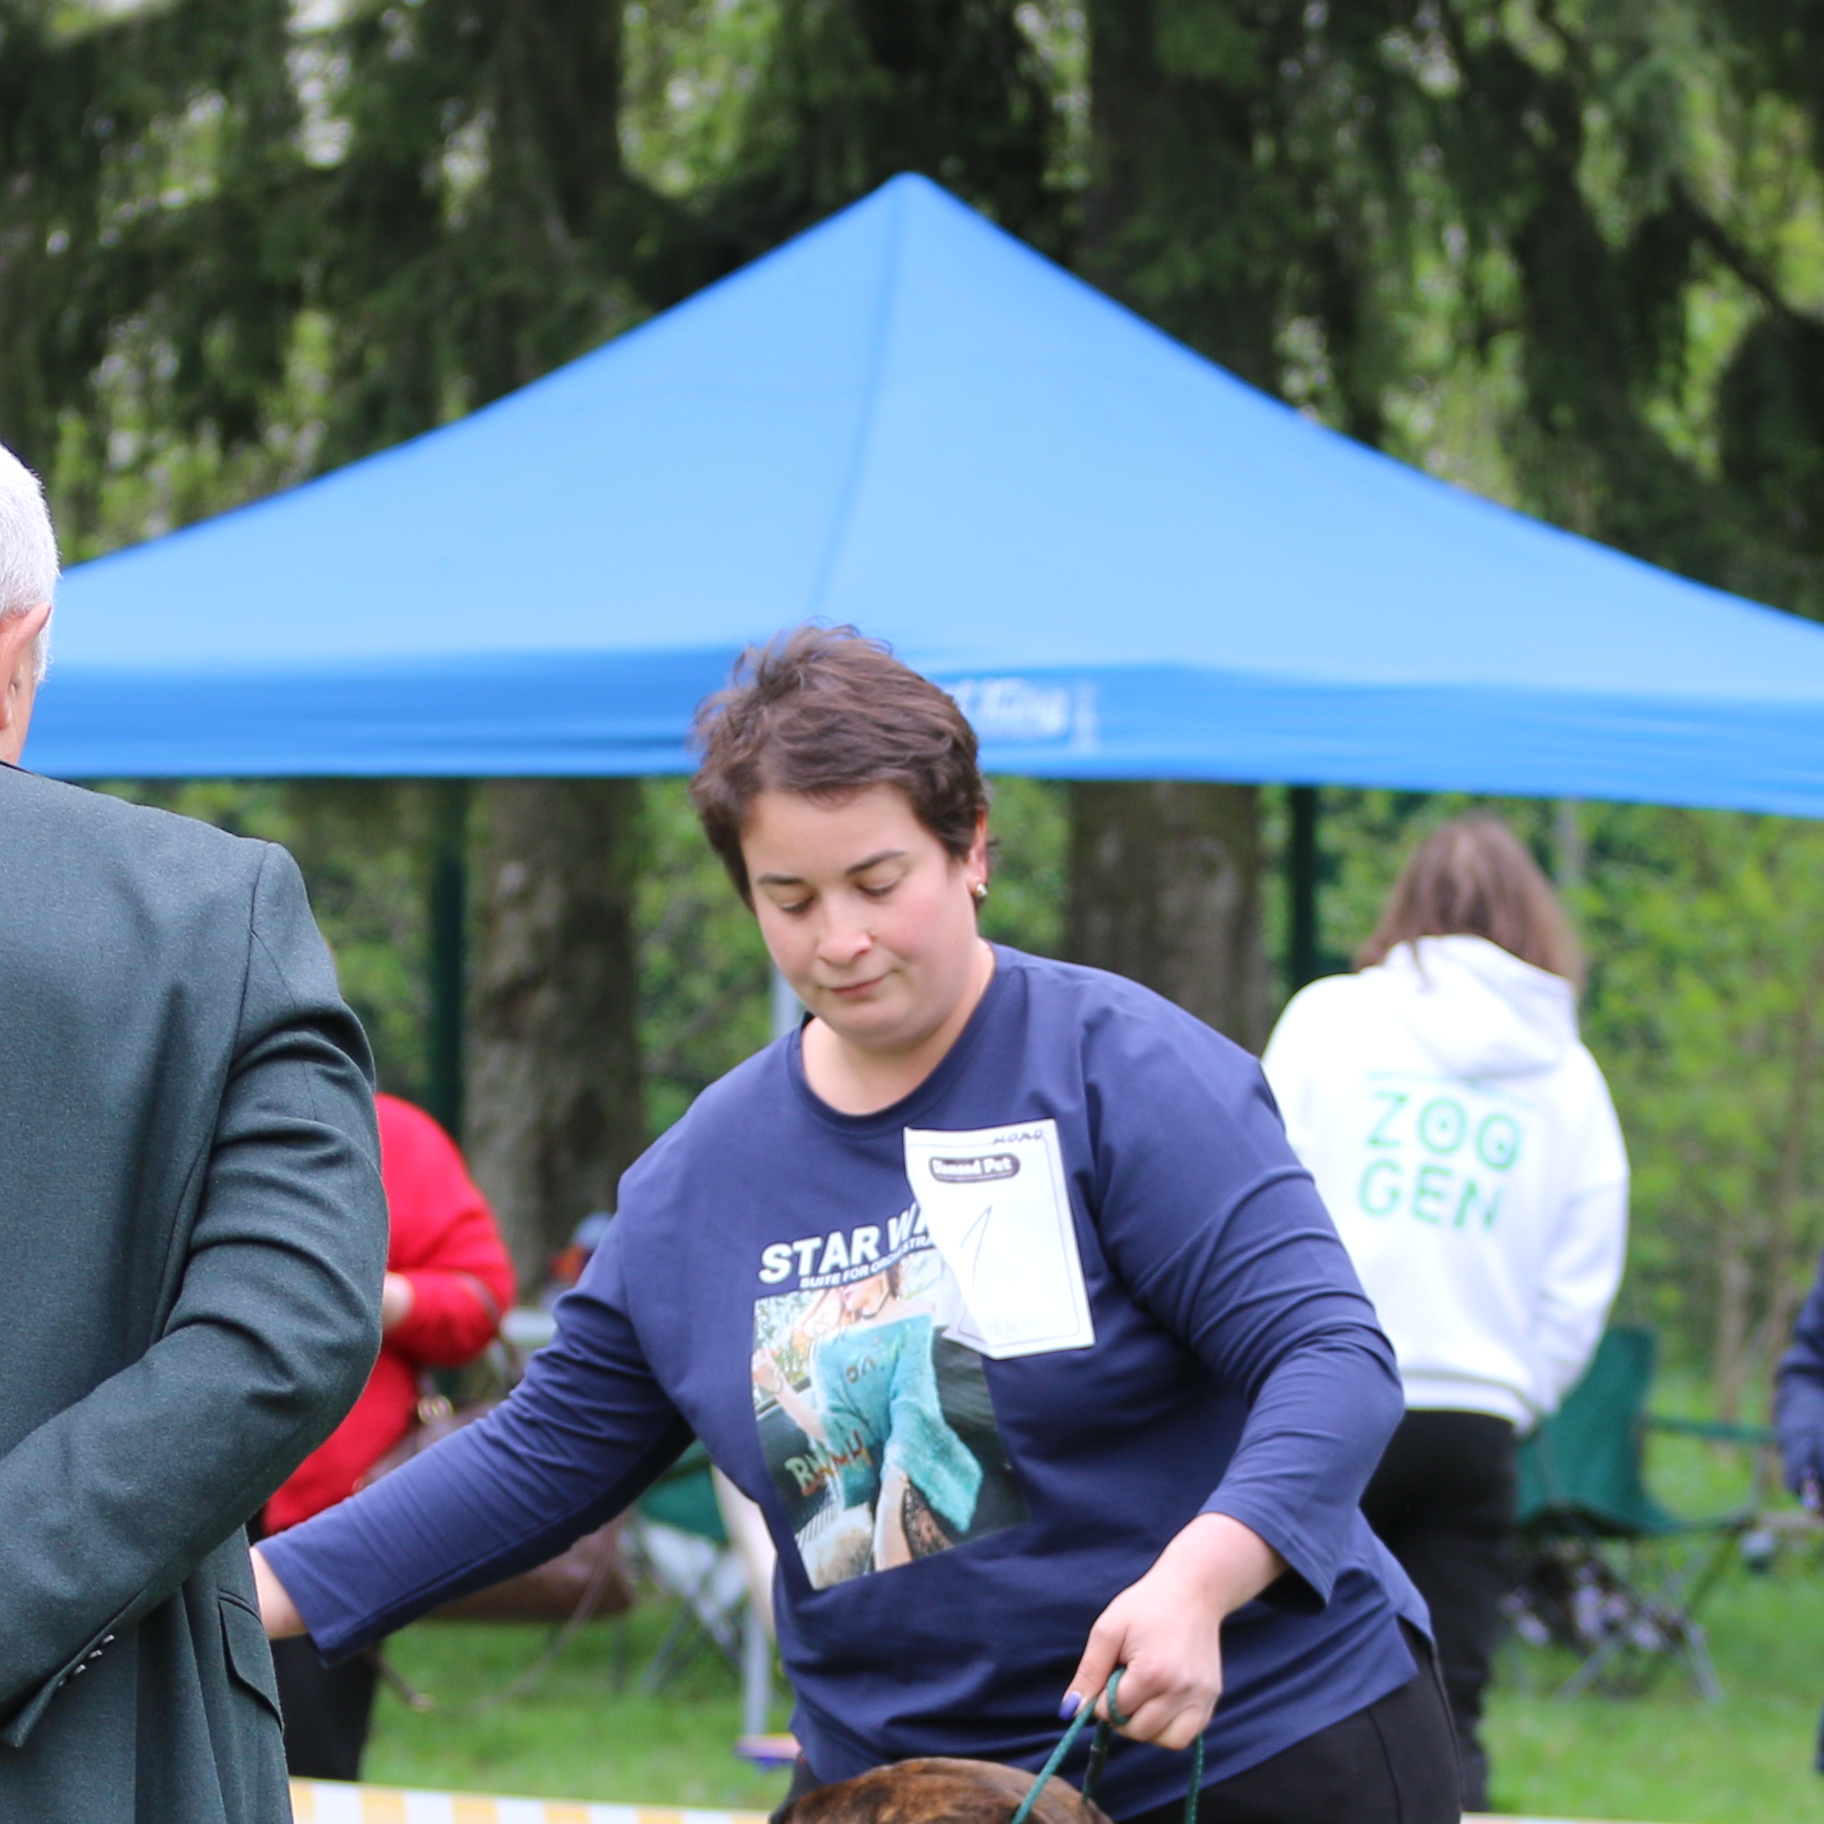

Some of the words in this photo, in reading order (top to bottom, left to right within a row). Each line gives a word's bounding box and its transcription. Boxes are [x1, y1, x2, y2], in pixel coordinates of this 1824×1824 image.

[1365, 1090, 1522, 1173] ZOO
[932, 1158, 982, 1175] Diamond
[983, 1156, 1013, 1174] Pet
[1359, 1158, 1504, 1231] GEN
[758, 1225, 882, 1285] STAR
[799, 1271, 842, 1289] SUITE
[842, 1263, 870, 1283] FOR
